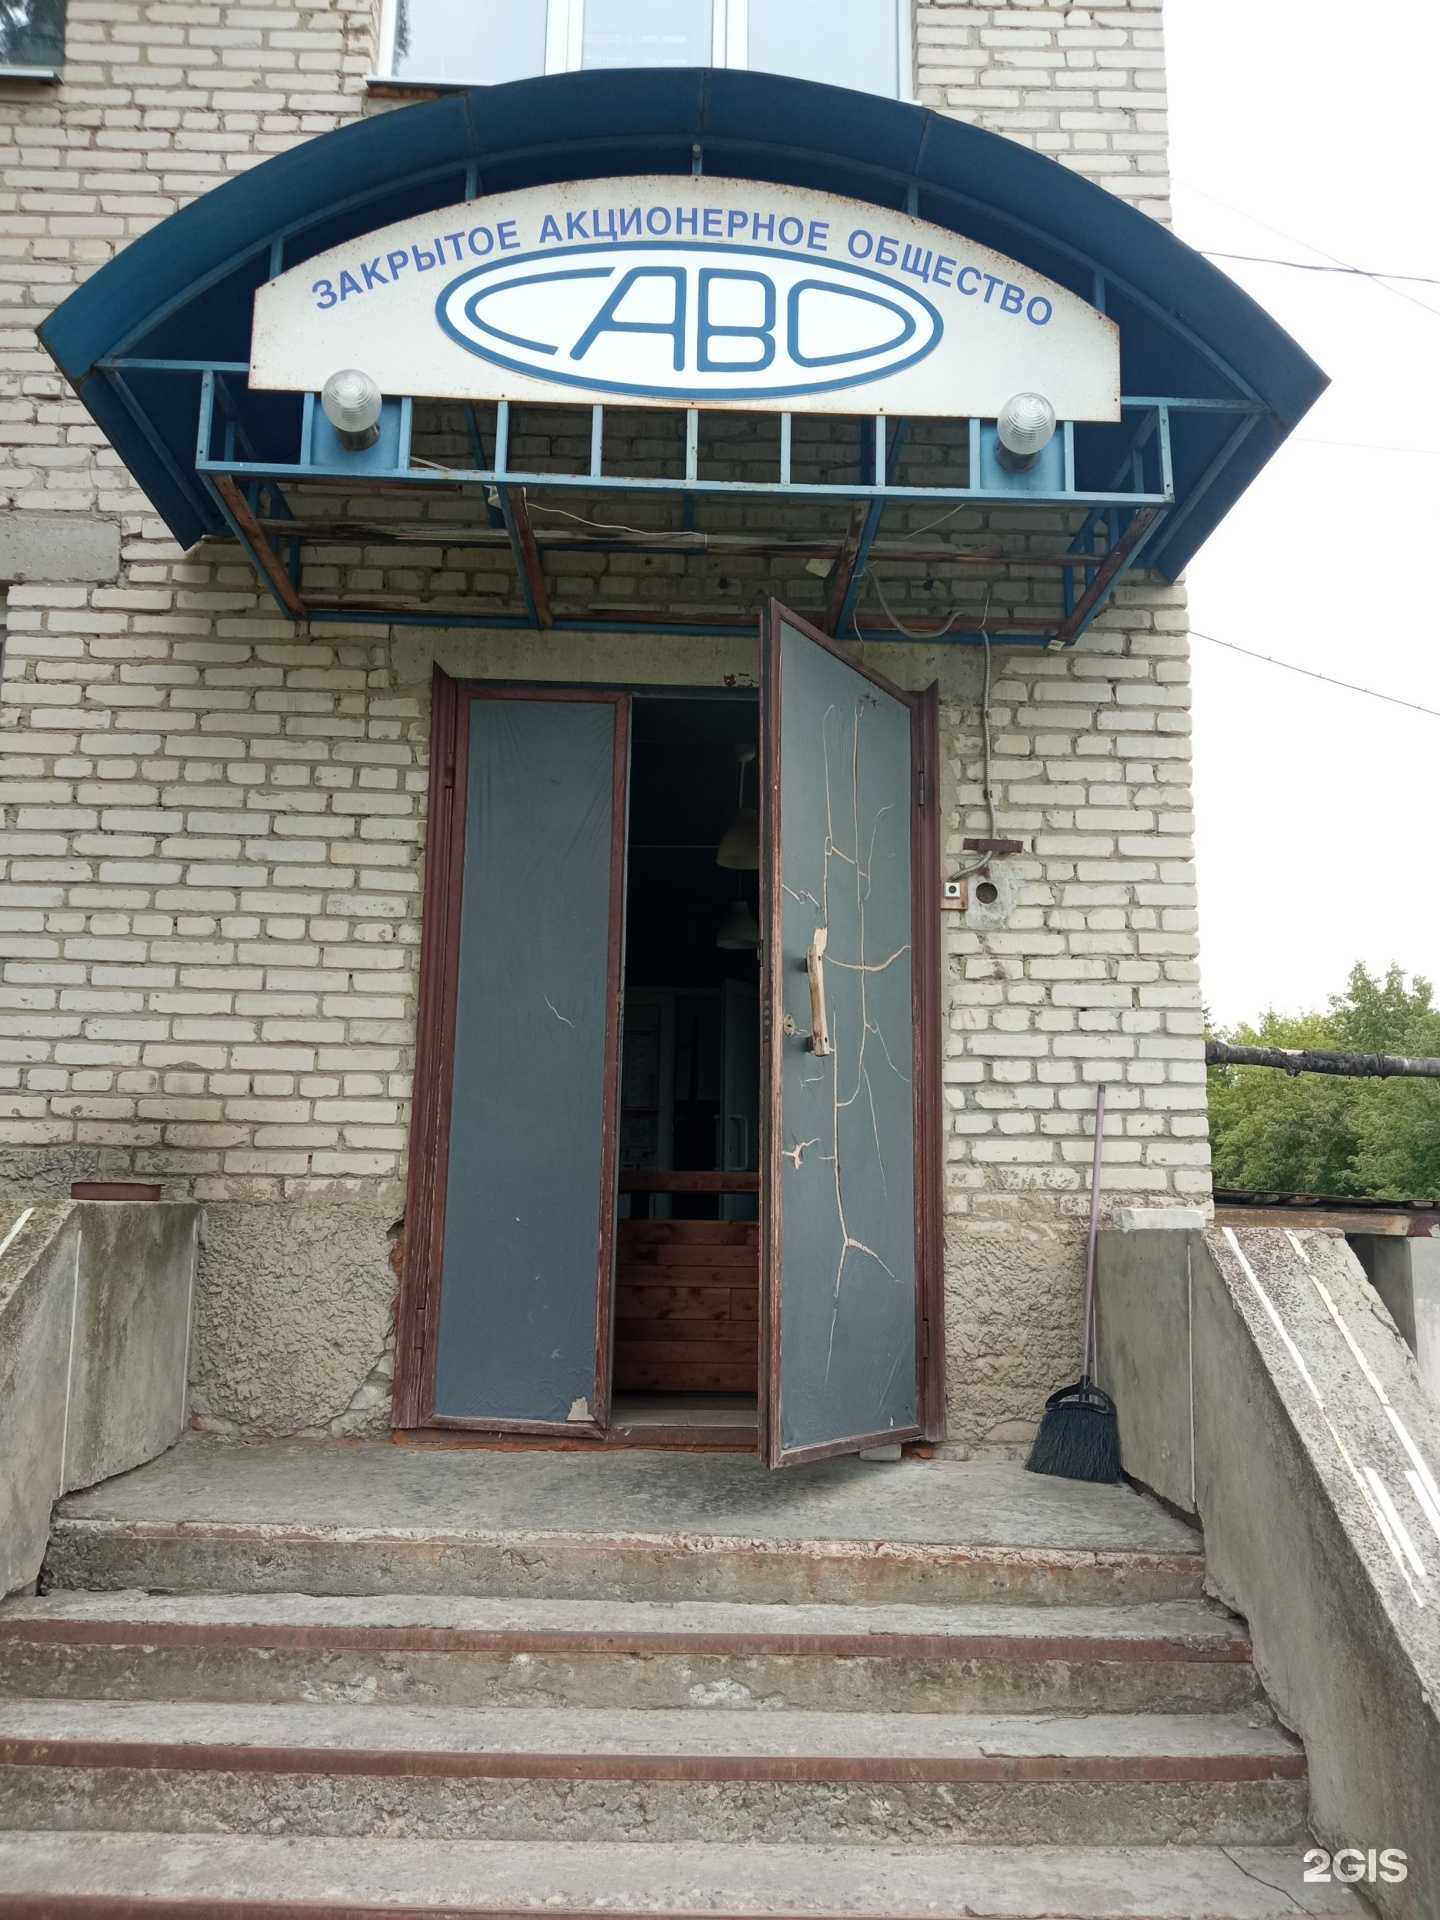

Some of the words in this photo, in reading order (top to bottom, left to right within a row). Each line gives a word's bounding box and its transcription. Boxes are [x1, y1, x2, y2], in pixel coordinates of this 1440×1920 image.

[312, 221, 522, 309] ЗАКРЫТОЕ
[539, 206, 830, 251] АКЦИОНЕРНОЕ
[847, 229, 1053, 326] ОБЩЕСТВО
